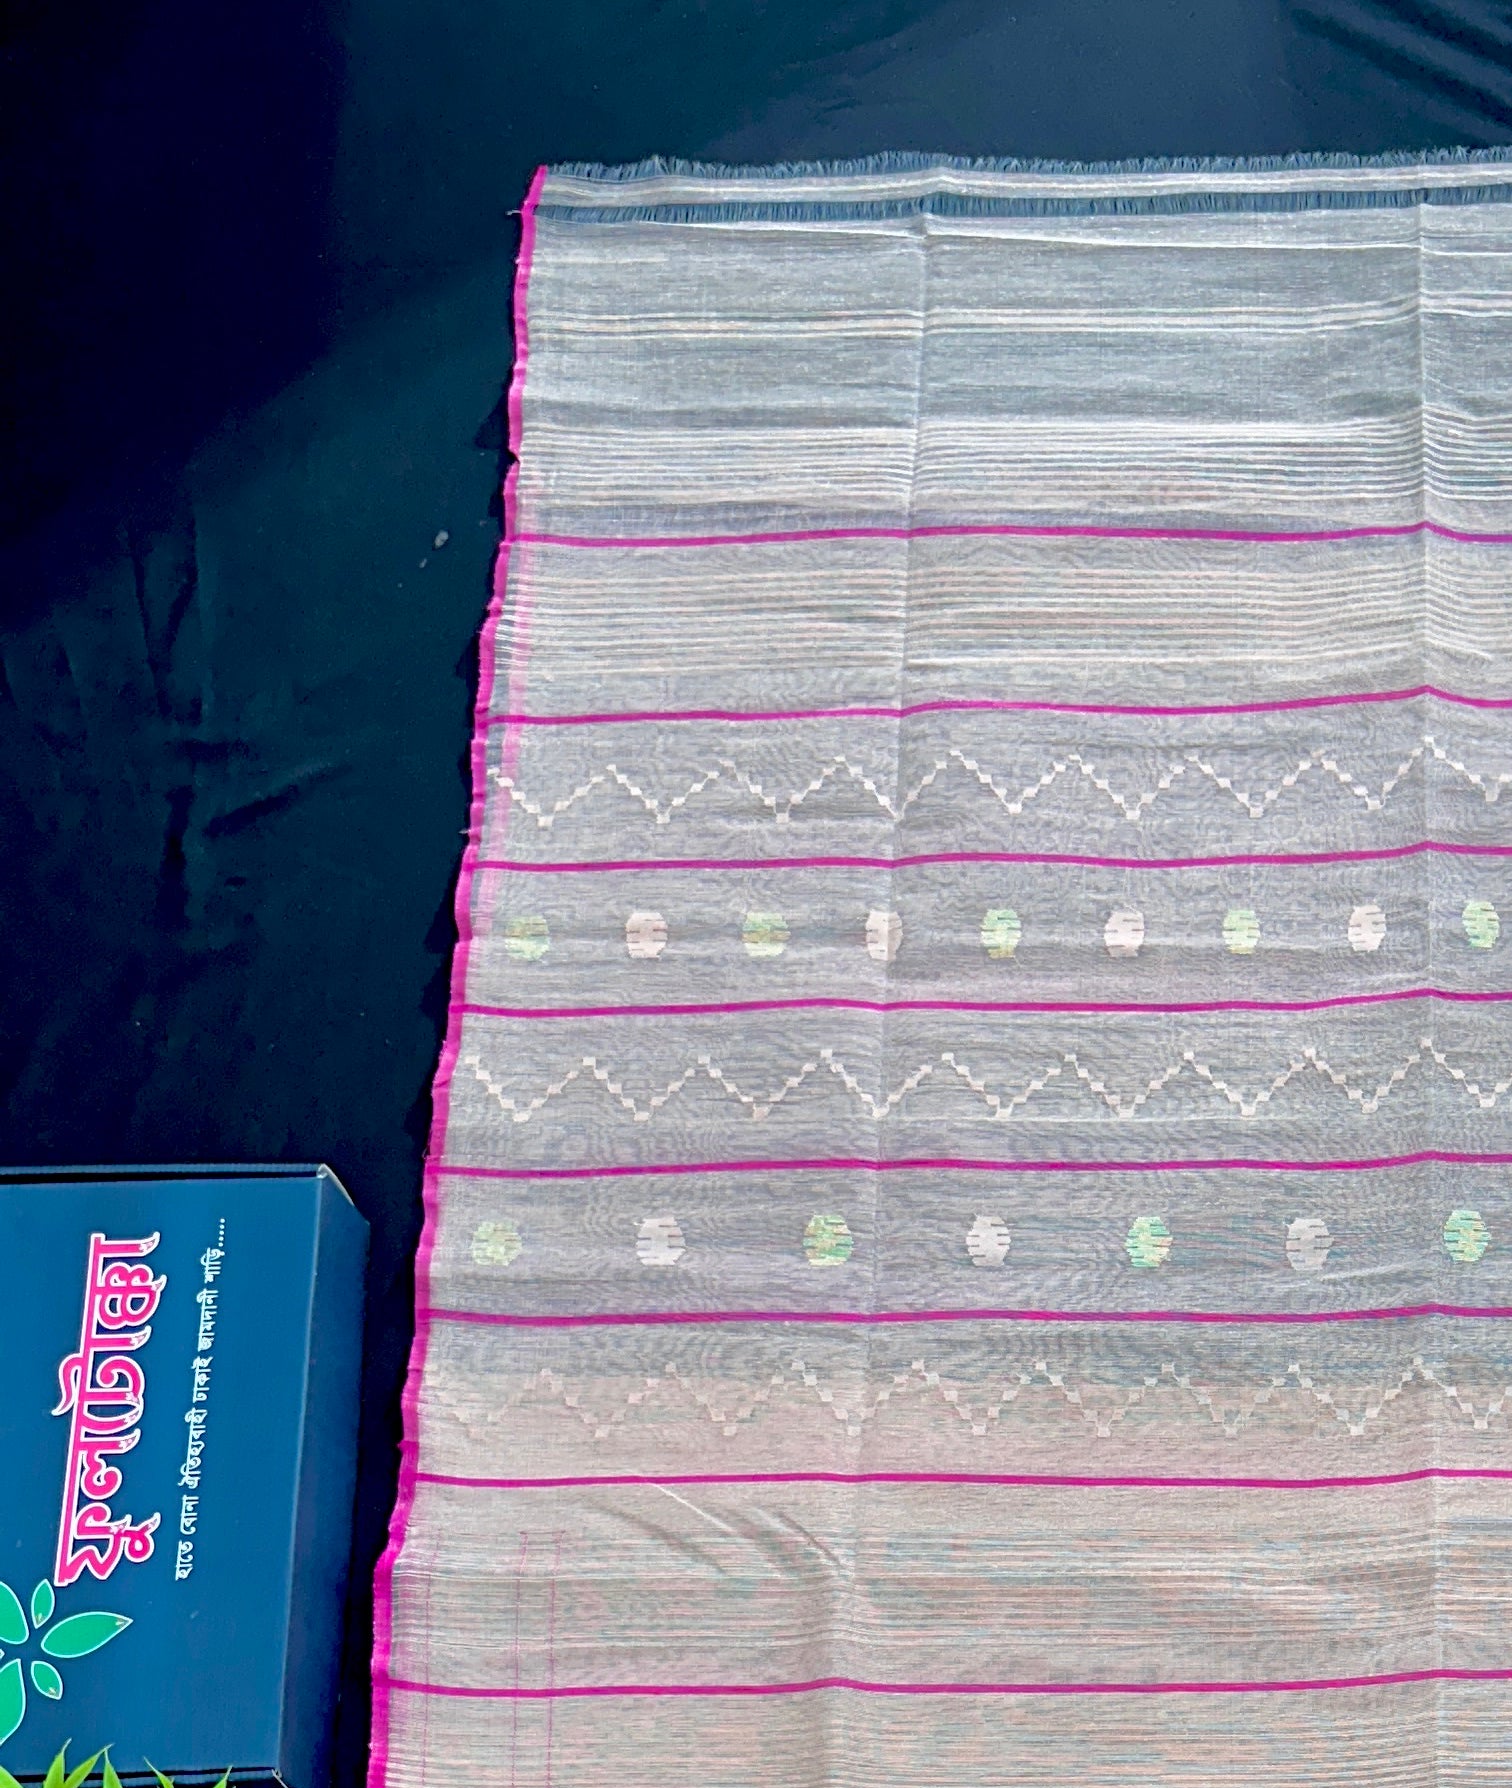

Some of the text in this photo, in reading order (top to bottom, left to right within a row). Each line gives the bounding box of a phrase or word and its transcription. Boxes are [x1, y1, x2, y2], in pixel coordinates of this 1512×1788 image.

[197, 1289, 218, 1351] জামদানী
[192, 1357, 212, 1403] ঢাকাই
[51, 1231, 168, 1587] ফুলটোক্কা
[180, 1495, 198, 1534] বোনা
[176, 1541, 193, 1580] হাতে
